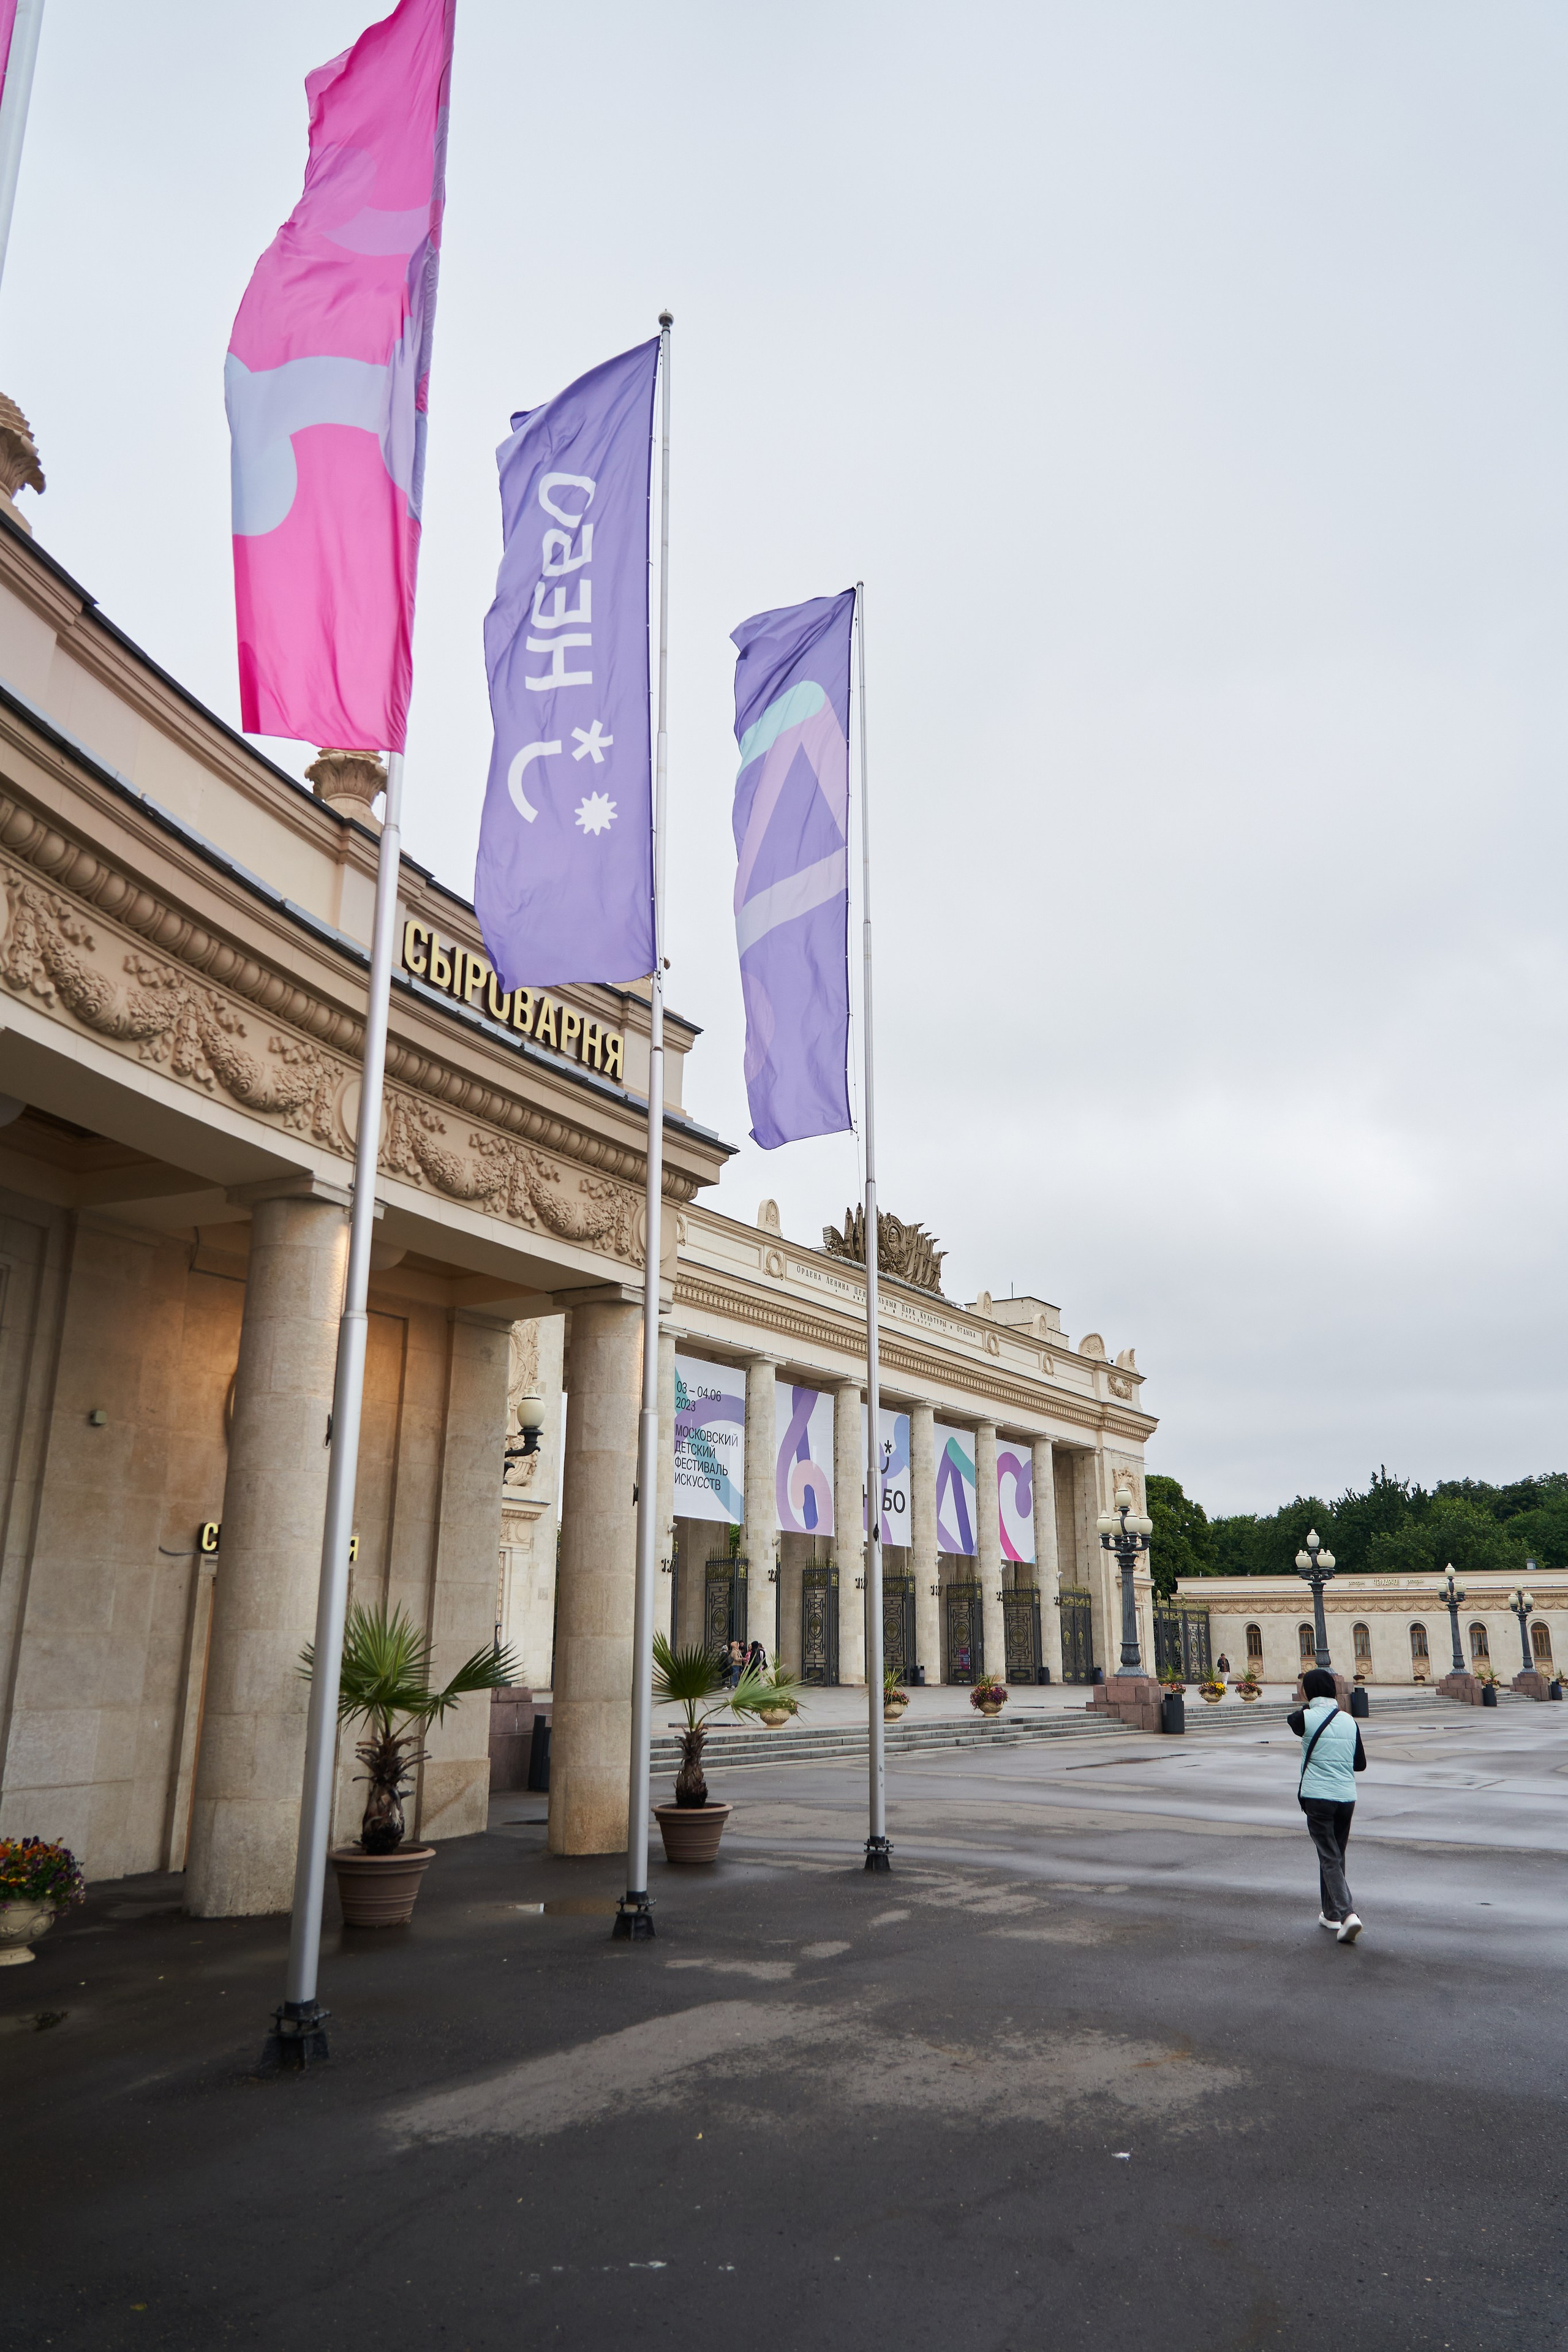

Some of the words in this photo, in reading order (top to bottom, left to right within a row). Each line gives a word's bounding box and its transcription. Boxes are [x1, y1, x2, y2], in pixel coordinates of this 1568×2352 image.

[402, 920, 624, 1080] СЫРОВАРНЯ
[797, 1265, 821, 1281] ОРДЕНА
[826, 1276, 849, 1291] ЛЕНИНА
[902, 1304, 916, 1316] ПАРК
[920, 1311, 947, 1328] КУЛЬТУРЫ
[956, 1325, 976, 1338] ОТДЫХА
[677, 1381, 687, 1395] 03
[697, 1385, 722, 1402] 04.06
[676, 1396, 696, 1412] 2023
[676, 1424, 738, 1447] МОСКОВСКИЙ
[675, 1440, 715, 1459] ДЕТСКИЙ
[675, 1456, 728, 1476] ФЕСТИВАЛЬ
[674, 1472, 721, 1490] ИСКУССТВ
